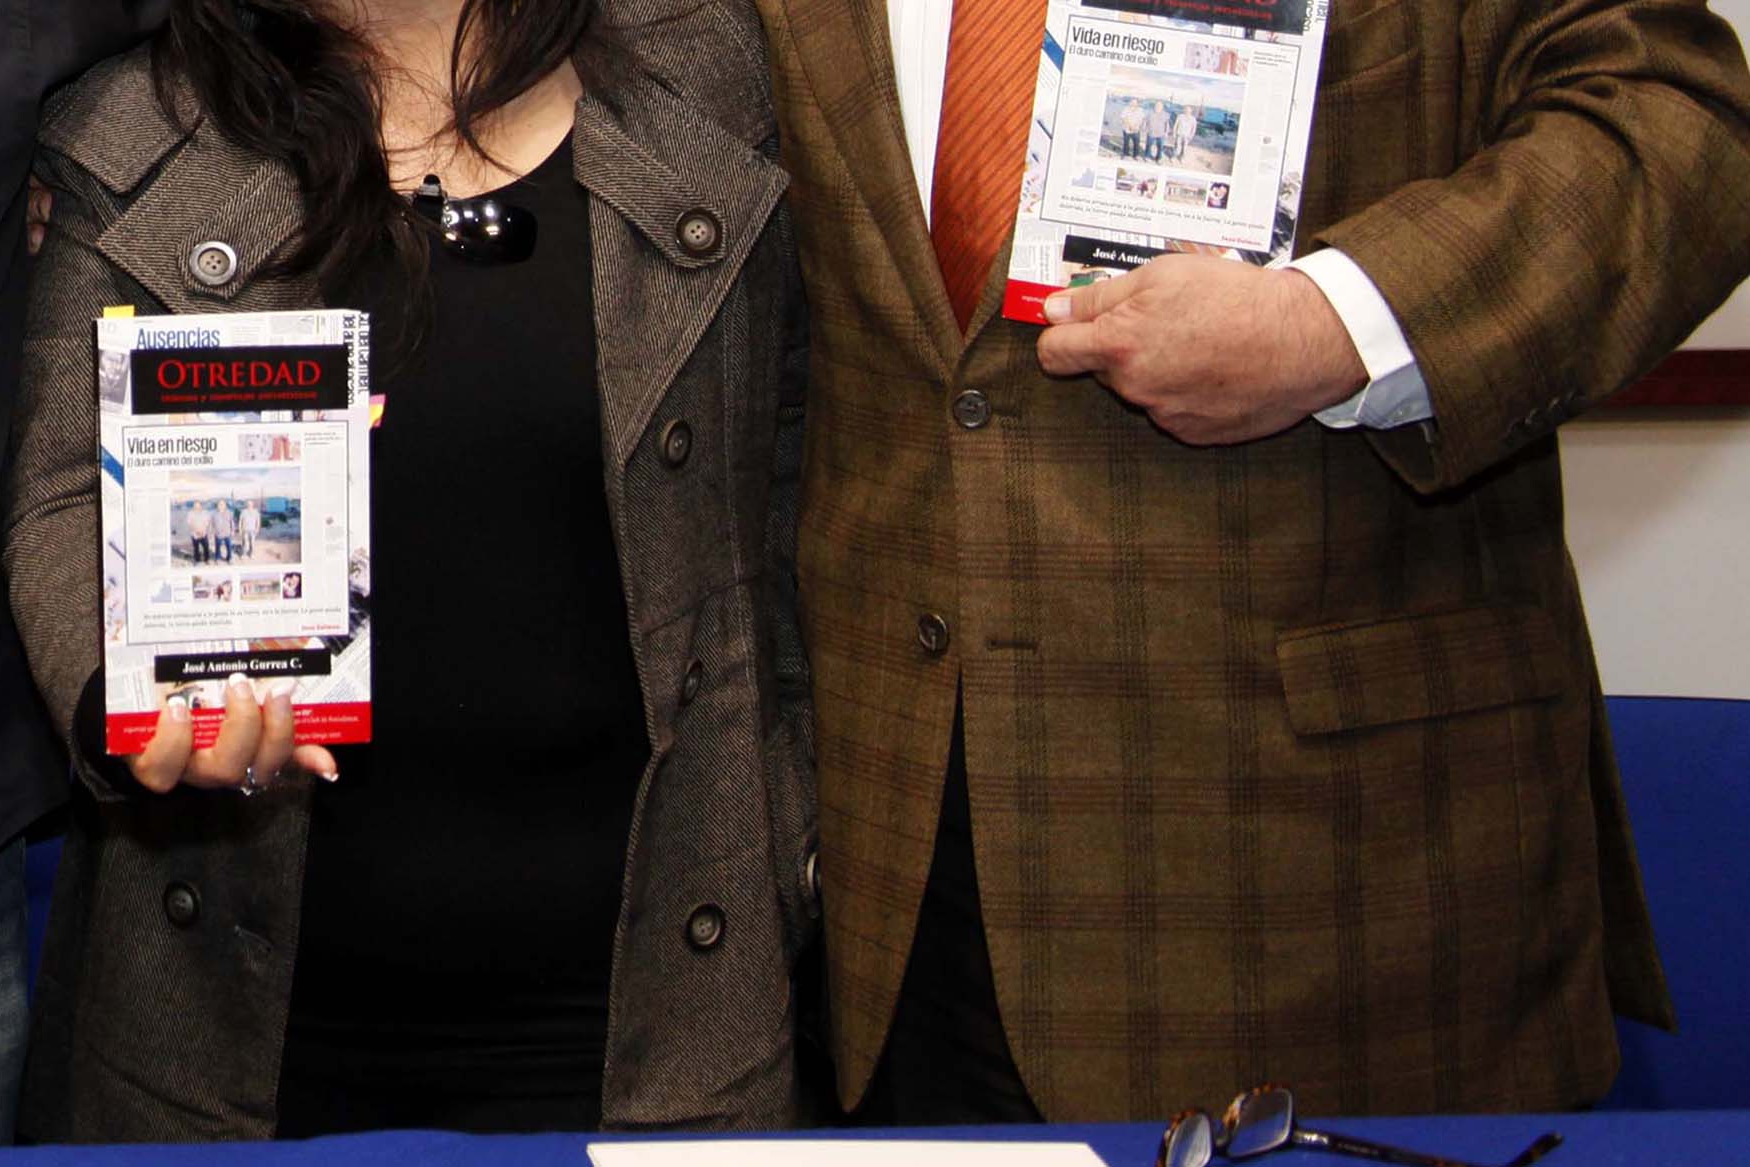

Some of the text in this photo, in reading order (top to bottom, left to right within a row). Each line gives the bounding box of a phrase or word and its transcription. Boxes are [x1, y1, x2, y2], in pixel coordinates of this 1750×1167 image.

[1072, 26, 1165, 56] Vida en riesgo
[1092, 247, 1118, 262] José
[136, 326, 221, 349] Ausencias
[127, 436, 218, 455] Vida en riesgo
[182, 657, 303, 674] José Antonio Gurrea C.
